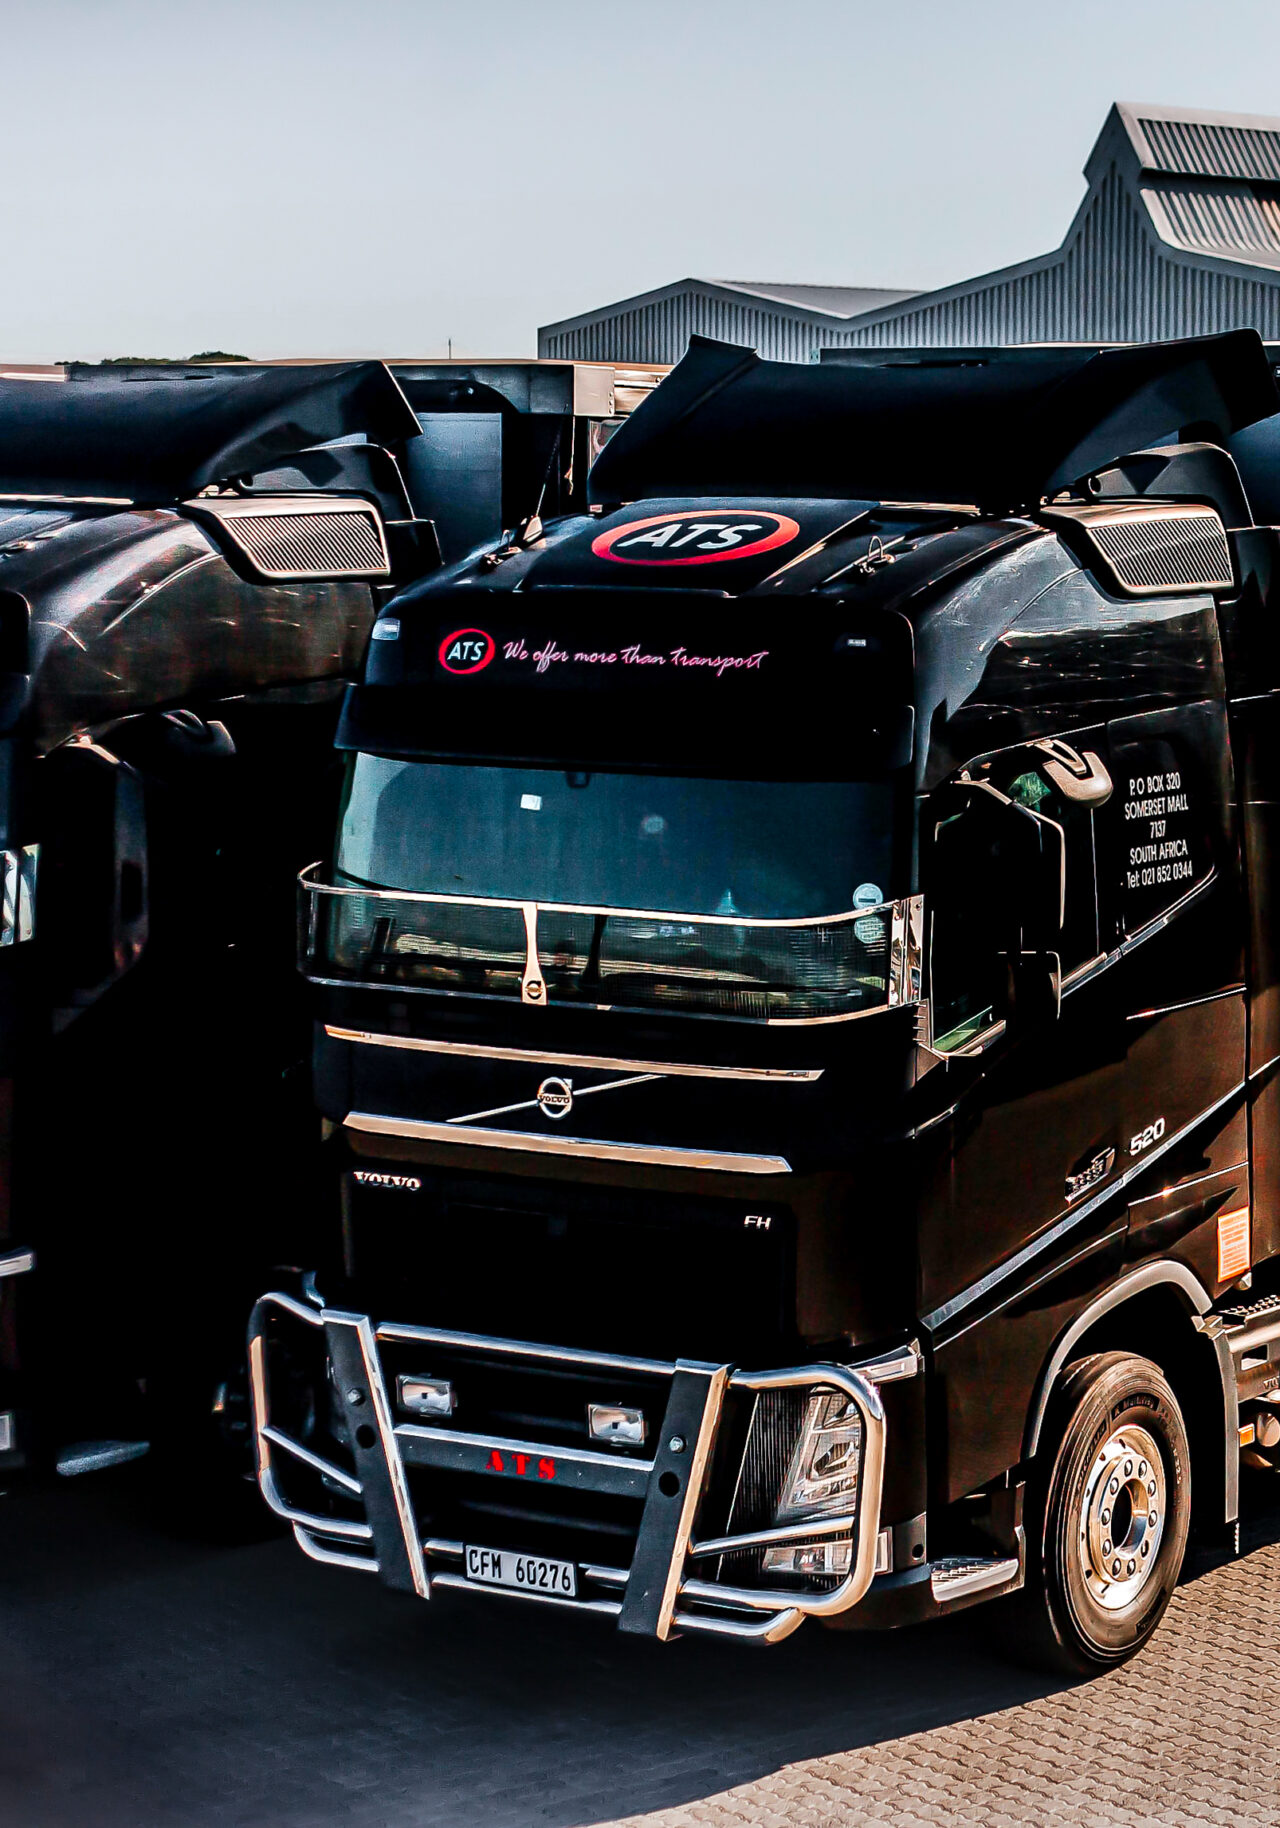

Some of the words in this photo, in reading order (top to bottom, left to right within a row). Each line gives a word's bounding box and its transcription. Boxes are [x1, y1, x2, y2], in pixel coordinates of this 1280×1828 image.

[617, 524, 762, 549] ATS
[447, 641, 485, 661] ATS
[503, 639, 528, 660] We
[532, 641, 569, 673] offer
[574, 650, 617, 663] more
[620, 644, 666, 665] than
[670, 647, 769, 677] transport
[1147, 774, 1165, 793] BOX
[1166, 771, 1181, 791] 320
[1124, 797, 1166, 820] SOMERSET
[1167, 793, 1189, 813] MALL
[1149, 820, 1166, 839] 7137
[1129, 844, 1157, 866] SOUTH
[1158, 839, 1189, 860] AFRICA
[1141, 867, 1156, 886] 021
[1156, 864, 1172, 883] 852
[1172, 859, 1193, 880] 0344
[539, 1094, 571, 1104] VOLVO
[1130, 1117, 1166, 1156] 520
[353, 1171, 421, 1191] VOLVO
[744, 1215, 771, 1230] FH
[485, 1450, 556, 1480] ATS
[469, 1549, 502, 1579] CFM
[516, 1558, 571, 1591] 60276
